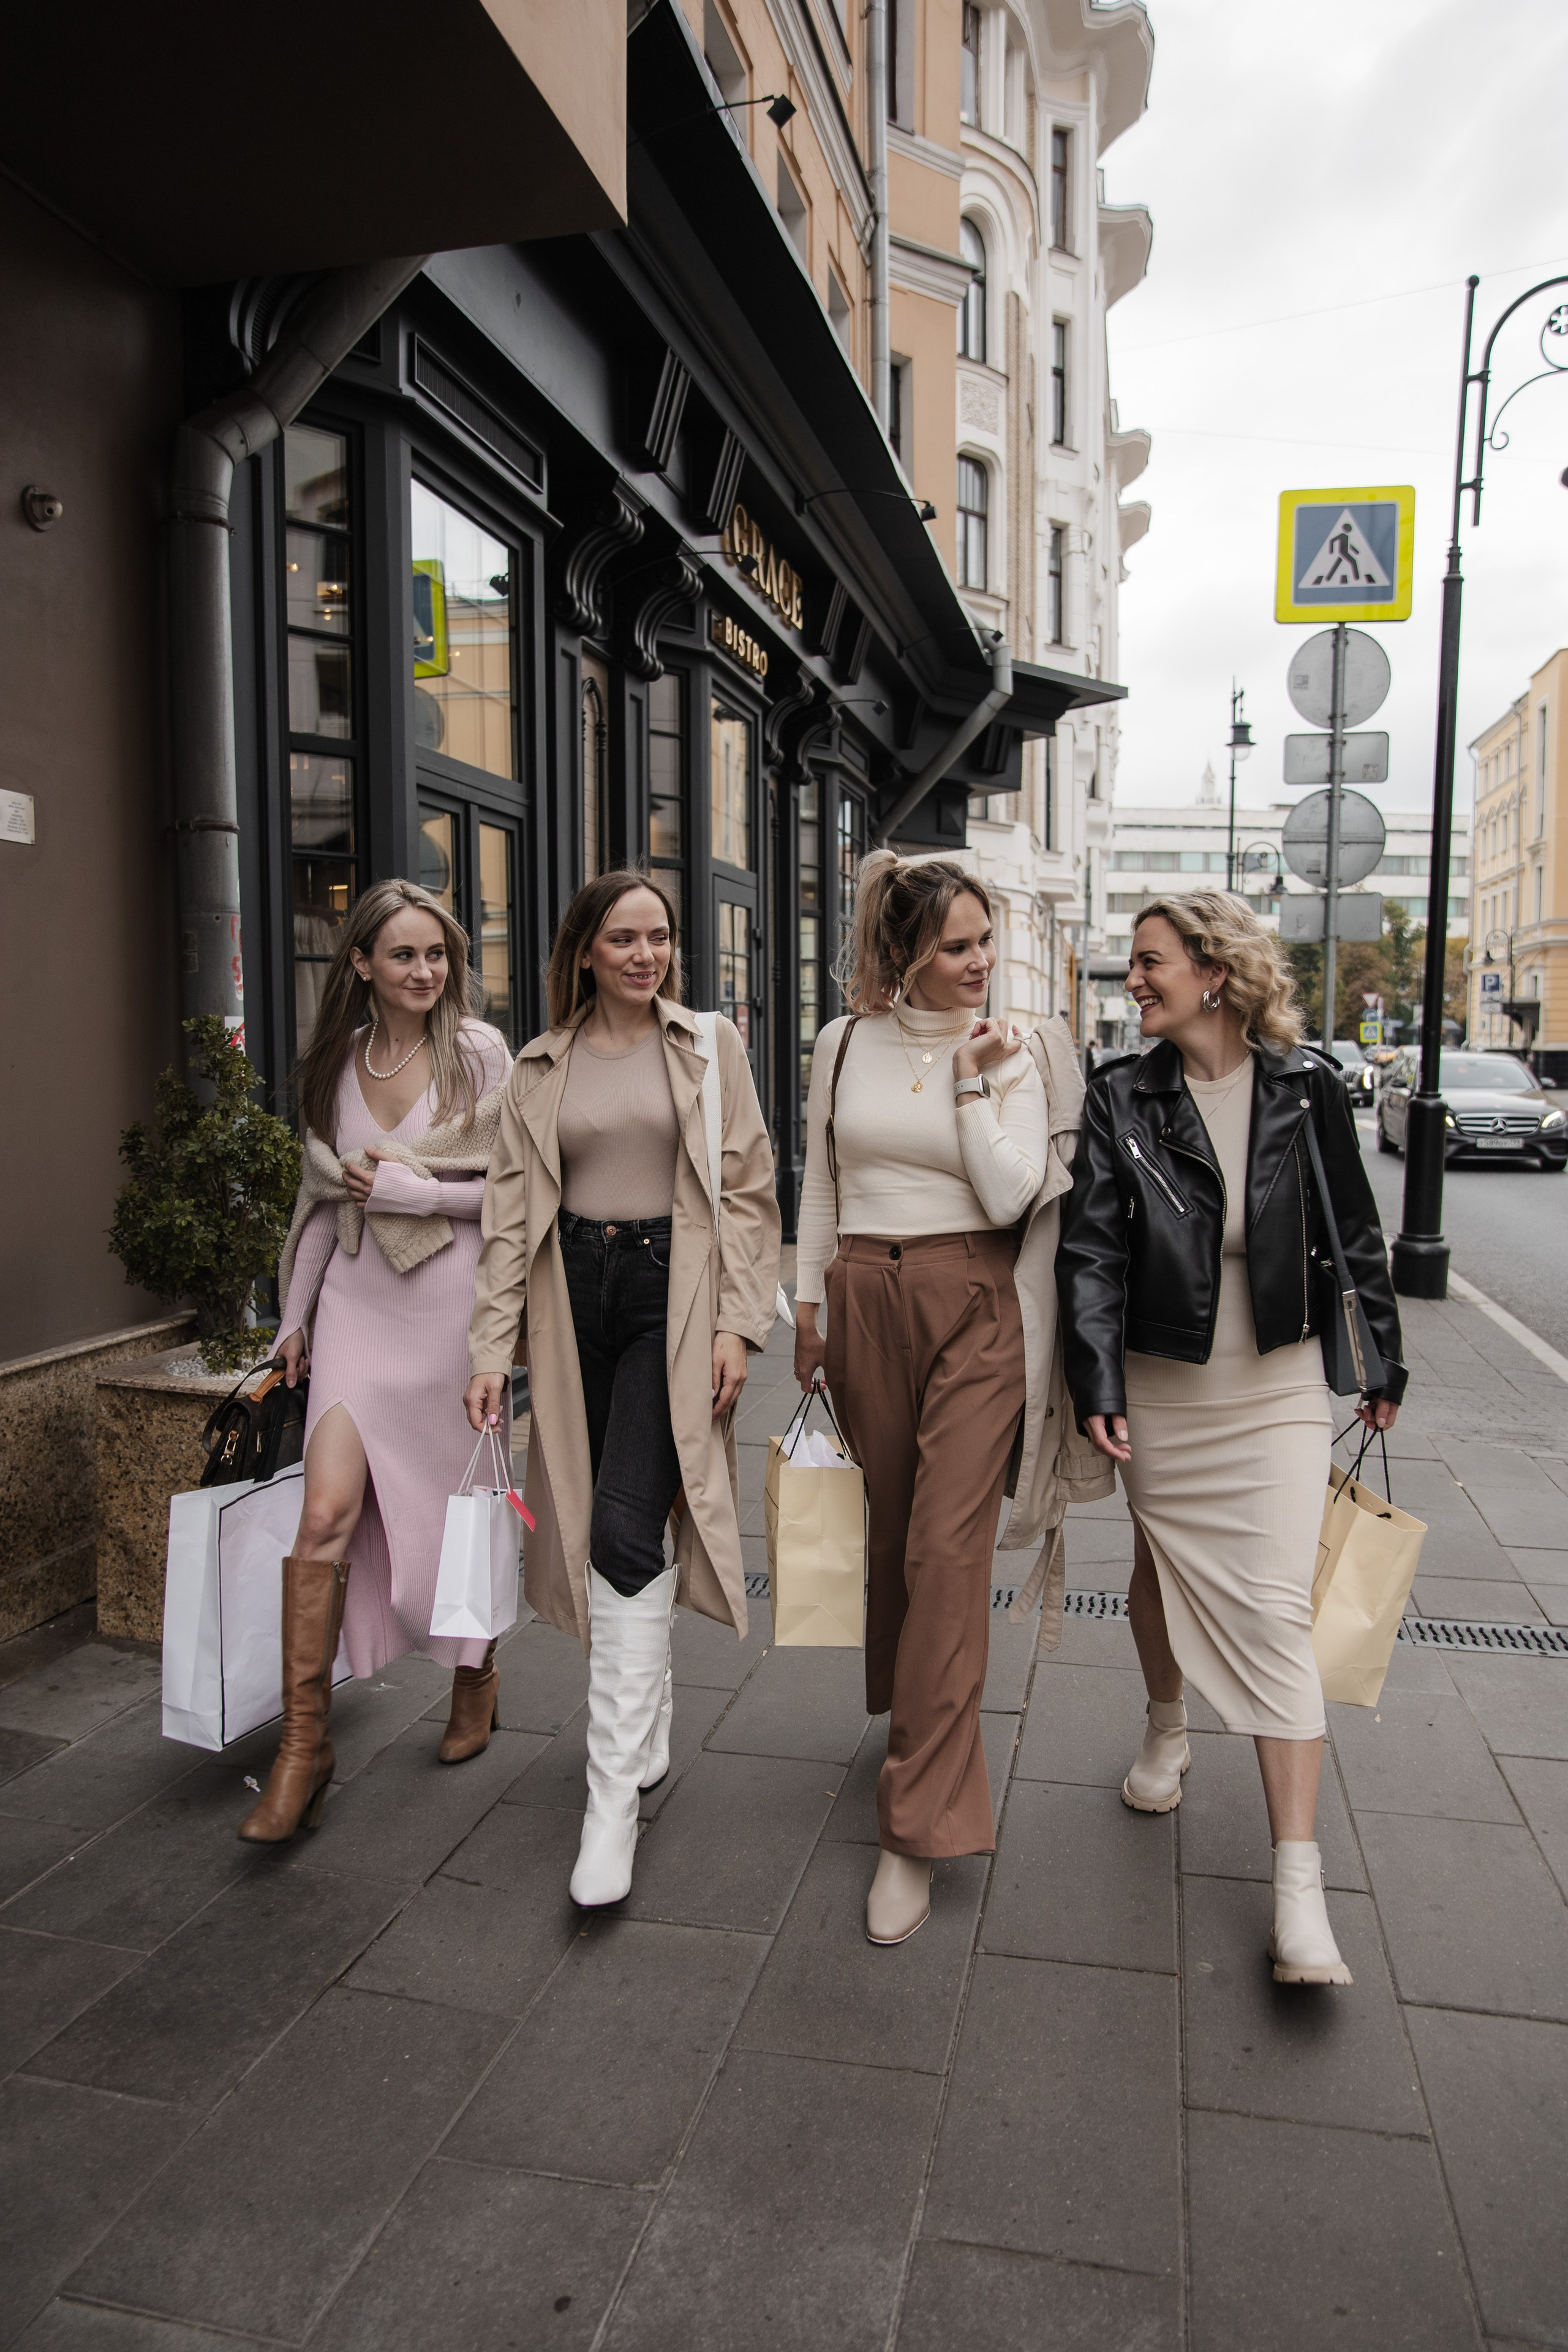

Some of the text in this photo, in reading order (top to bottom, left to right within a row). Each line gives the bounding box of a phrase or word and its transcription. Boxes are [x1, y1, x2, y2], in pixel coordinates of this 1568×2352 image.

[733, 504, 803, 630] GRACE
[725, 616, 769, 677] BISTRO
[1485, 976, 1496, 991] P
